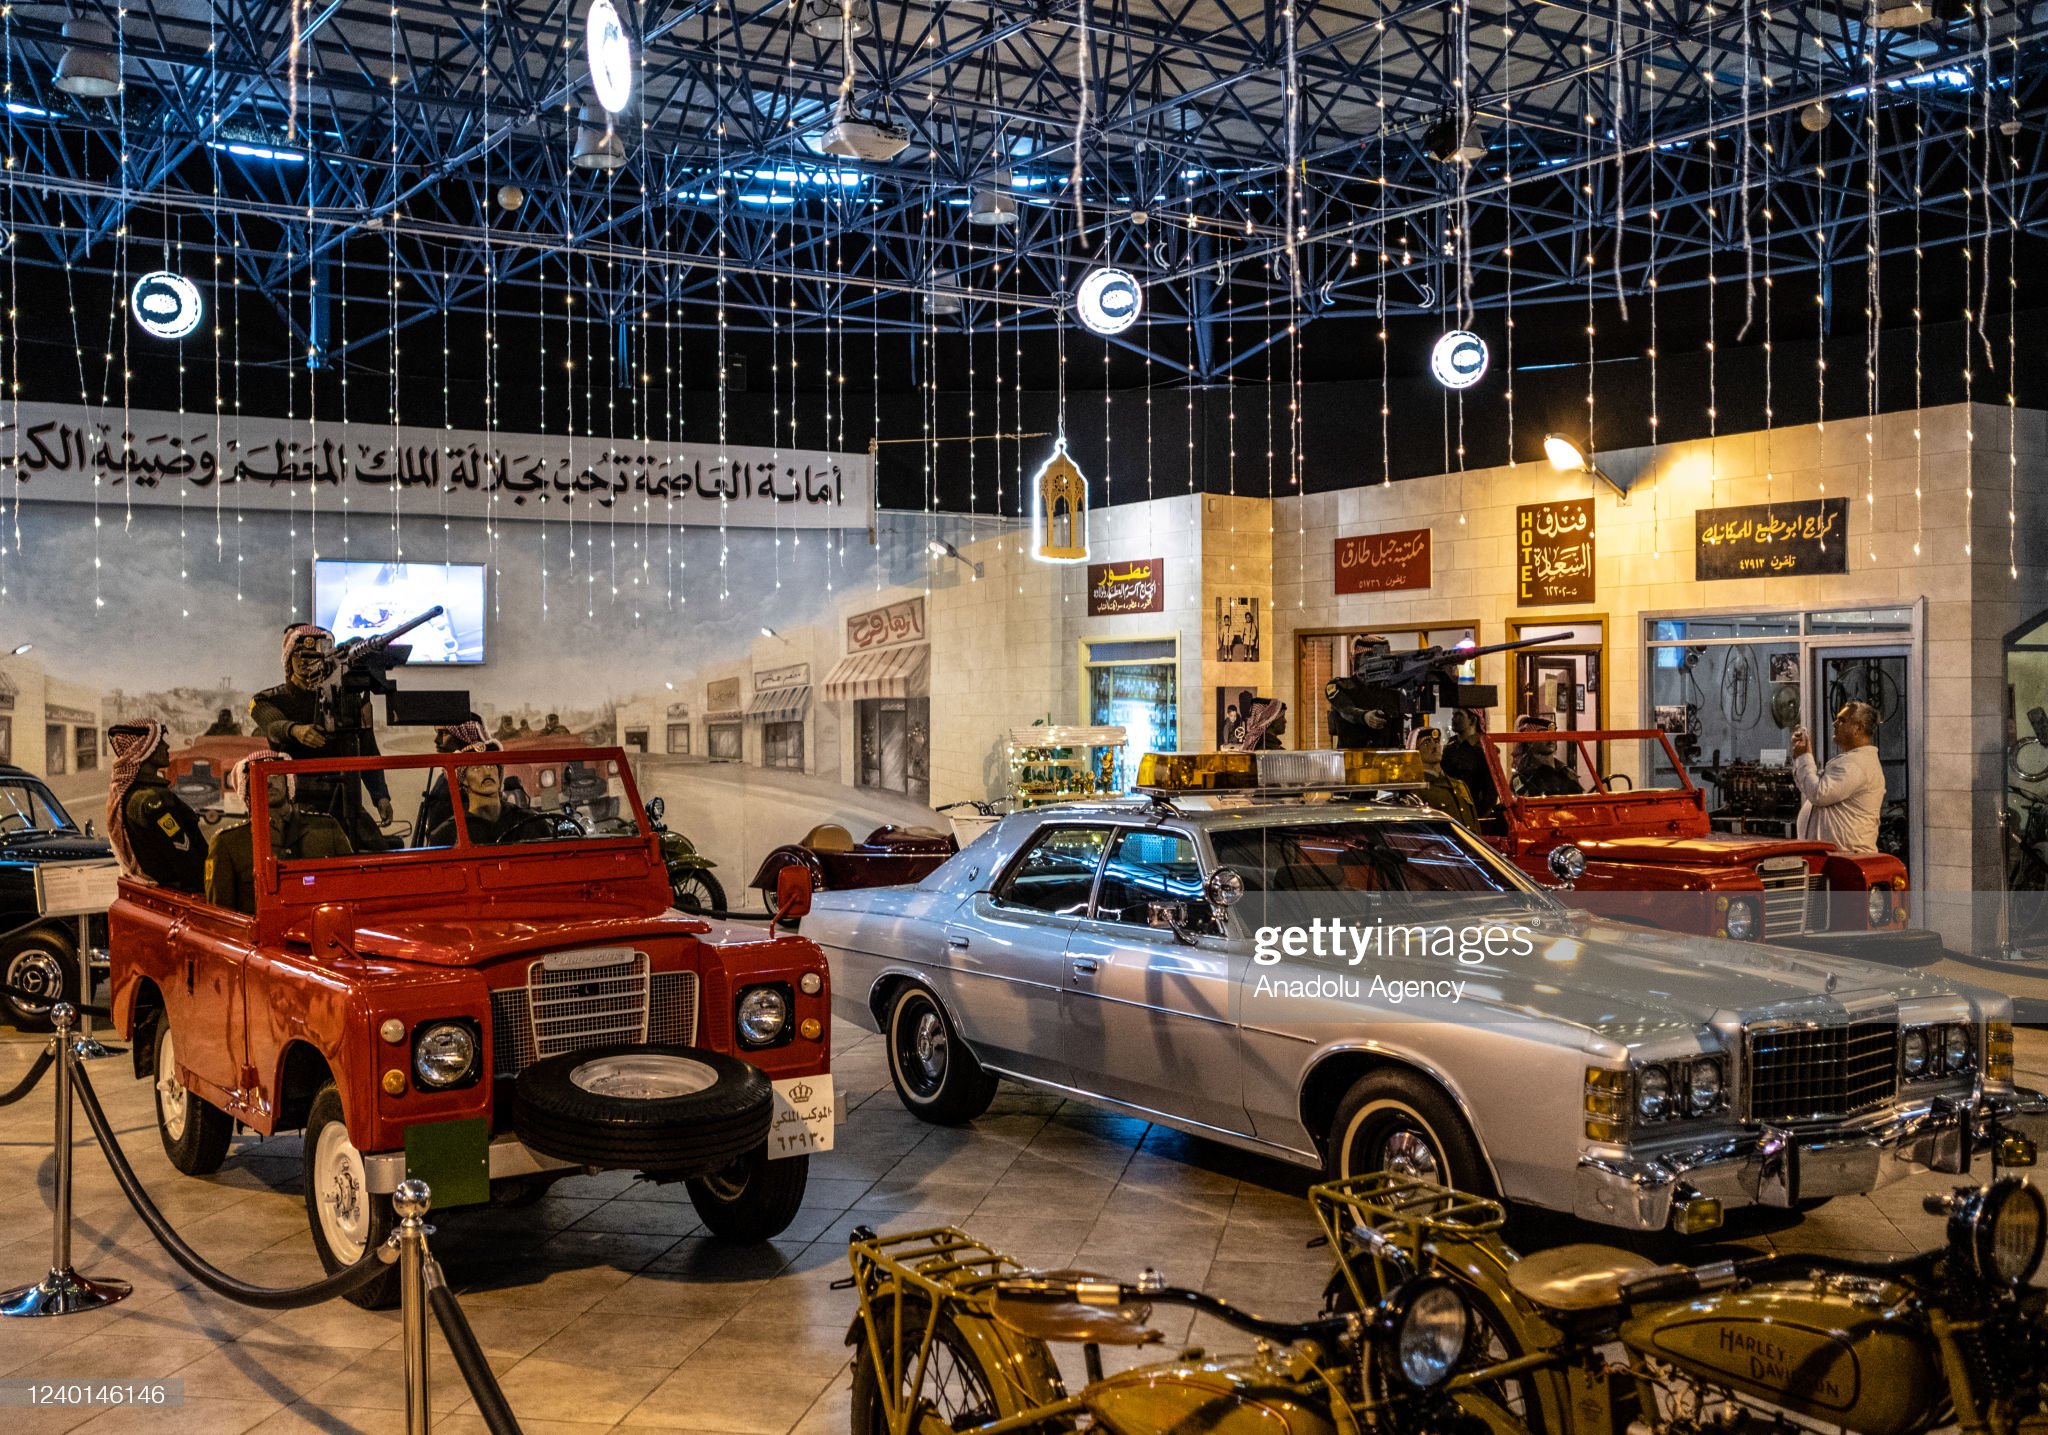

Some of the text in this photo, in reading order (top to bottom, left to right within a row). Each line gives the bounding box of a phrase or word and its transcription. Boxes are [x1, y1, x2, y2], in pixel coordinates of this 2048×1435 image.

[356, 438, 440, 488] الملك
[1536, 505, 1587, 538] فندق
[1802, 512, 1839, 539] كراج
[1341, 533, 1425, 568] مكتبة جبل طارق
[1521, 512, 1533, 598] HOTEL
[1770, 554, 1797, 570] تلفون
[1098, 562, 1151, 587] عطور
[772, 1110, 799, 1132] الملكي
[1750, 1356, 1840, 1398] DAVION
